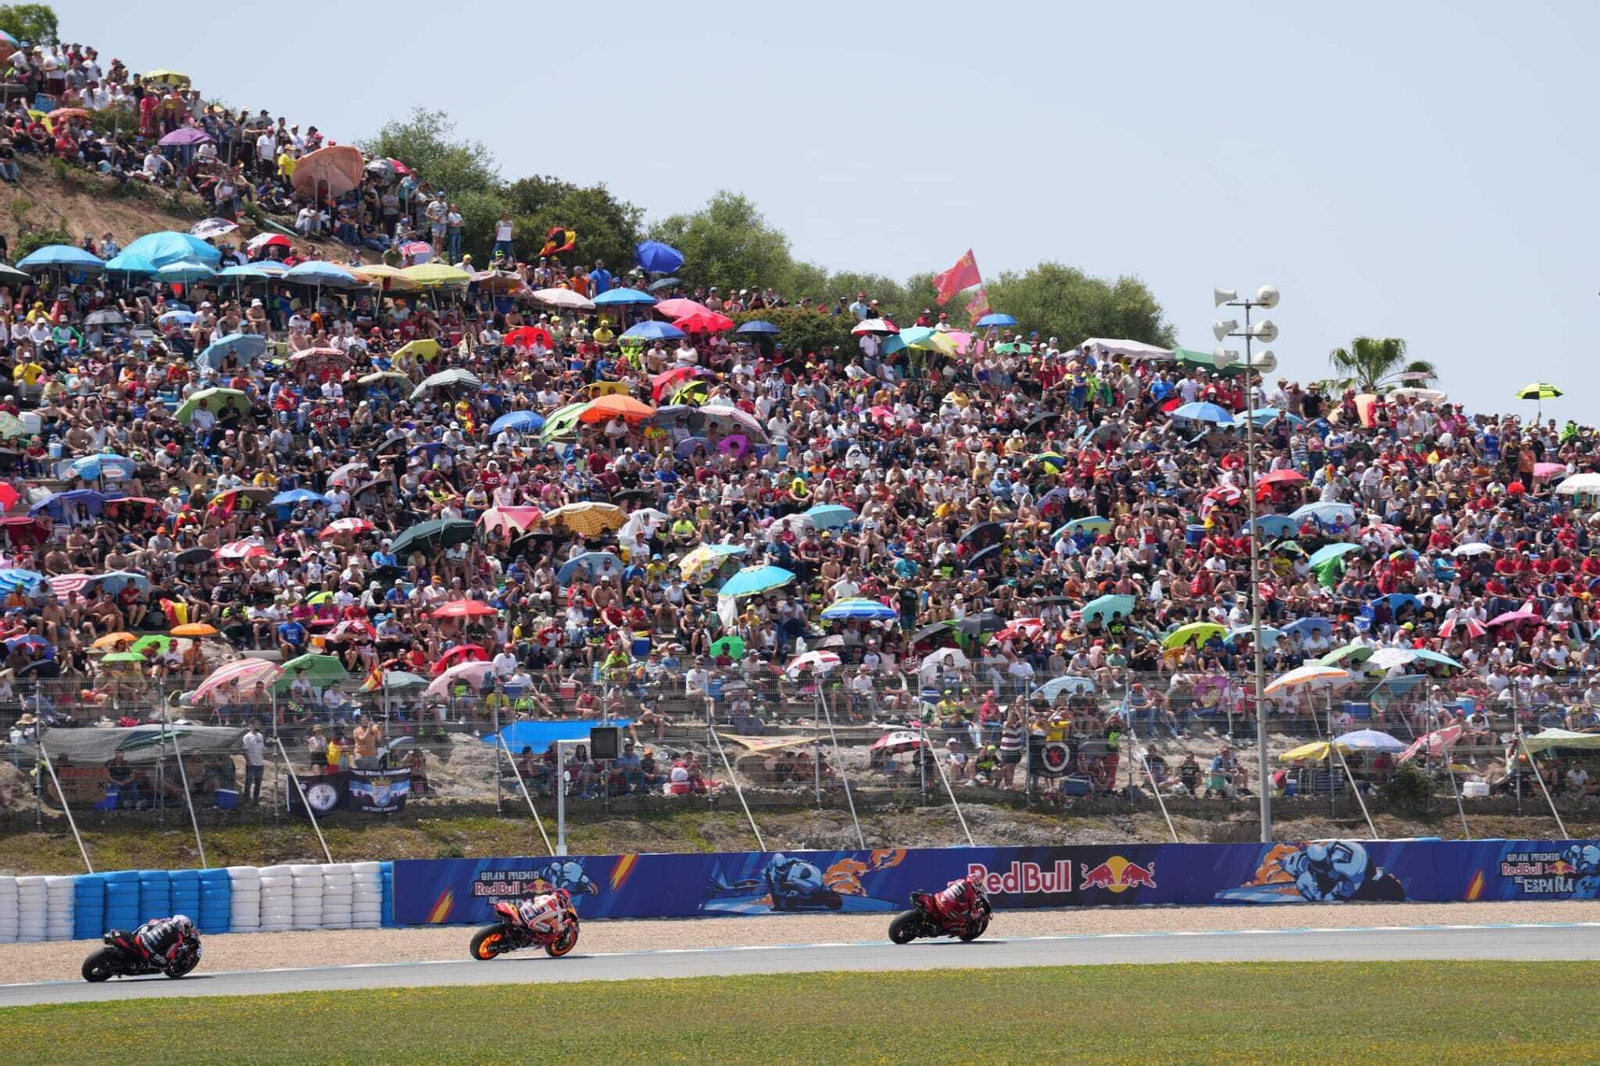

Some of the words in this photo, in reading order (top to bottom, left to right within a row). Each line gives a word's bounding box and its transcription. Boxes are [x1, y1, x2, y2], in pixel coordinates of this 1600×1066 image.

[1506, 853, 1529, 862] GRAN
[1531, 852, 1560, 862] PREMIO
[480, 871, 505, 881] GRAN
[508, 870, 540, 880] PREMIO
[1523, 875, 1575, 893] ESPAÑA
